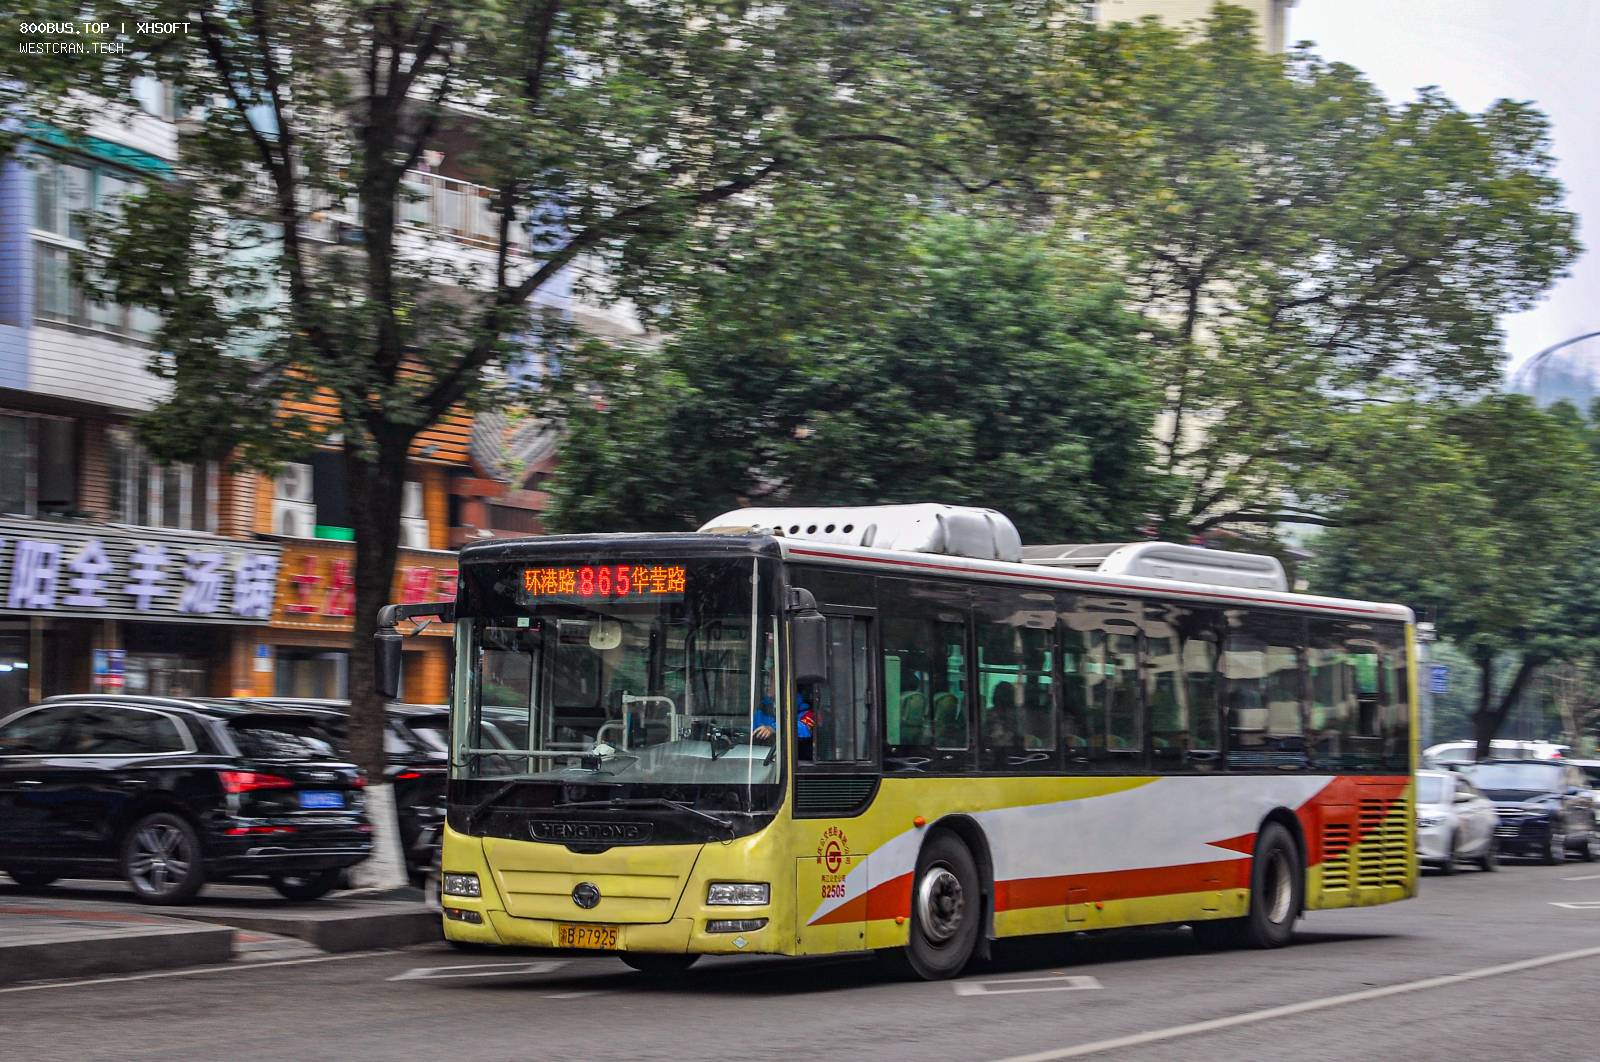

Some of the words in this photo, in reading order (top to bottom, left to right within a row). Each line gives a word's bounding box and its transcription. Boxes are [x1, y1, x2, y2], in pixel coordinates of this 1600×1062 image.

[0, 538, 280, 617] 阳全羊汤锅
[525, 568, 577, 596] 环港路
[579, 567, 631, 596] 865
[821, 885, 845, 898] 82505
